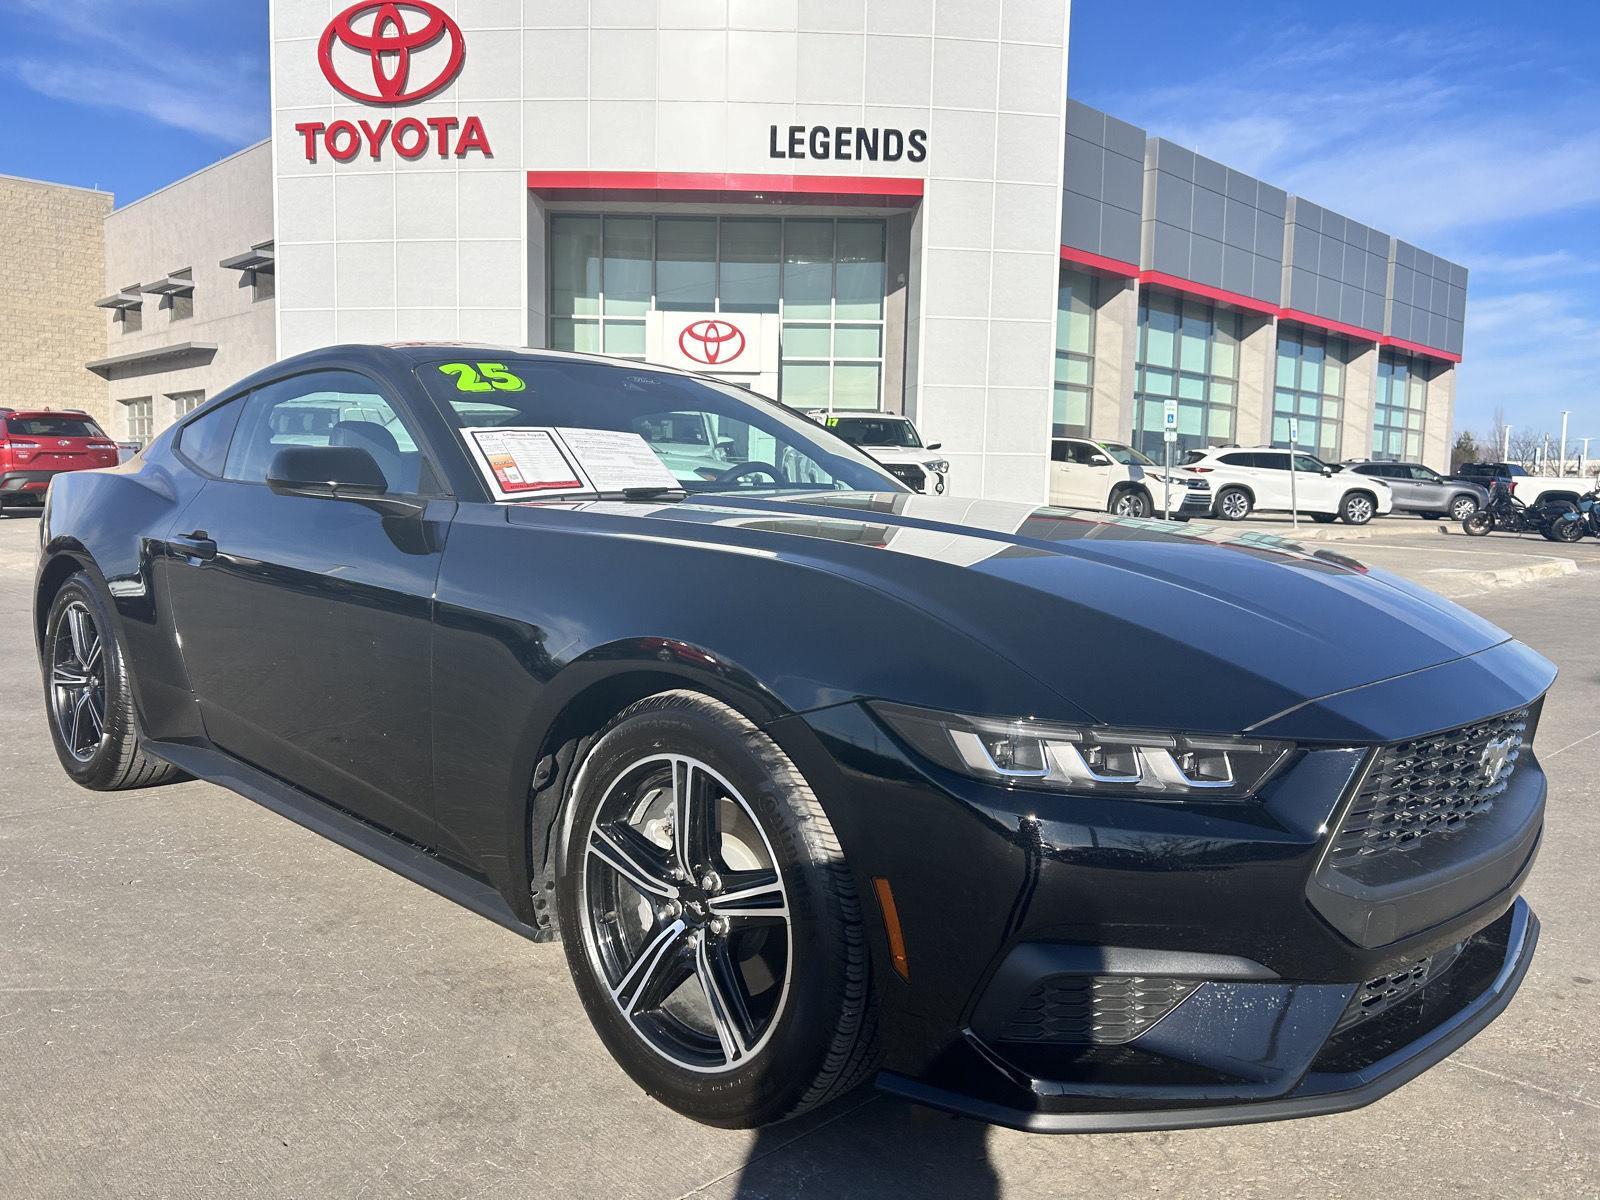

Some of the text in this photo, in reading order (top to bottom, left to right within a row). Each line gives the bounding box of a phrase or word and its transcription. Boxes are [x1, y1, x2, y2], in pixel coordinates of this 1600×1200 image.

[295, 116, 493, 164] TOYOTA
[770, 125, 928, 162] LEGENDS
[438, 362, 526, 392] 25
[825, 417, 839, 427] 17
